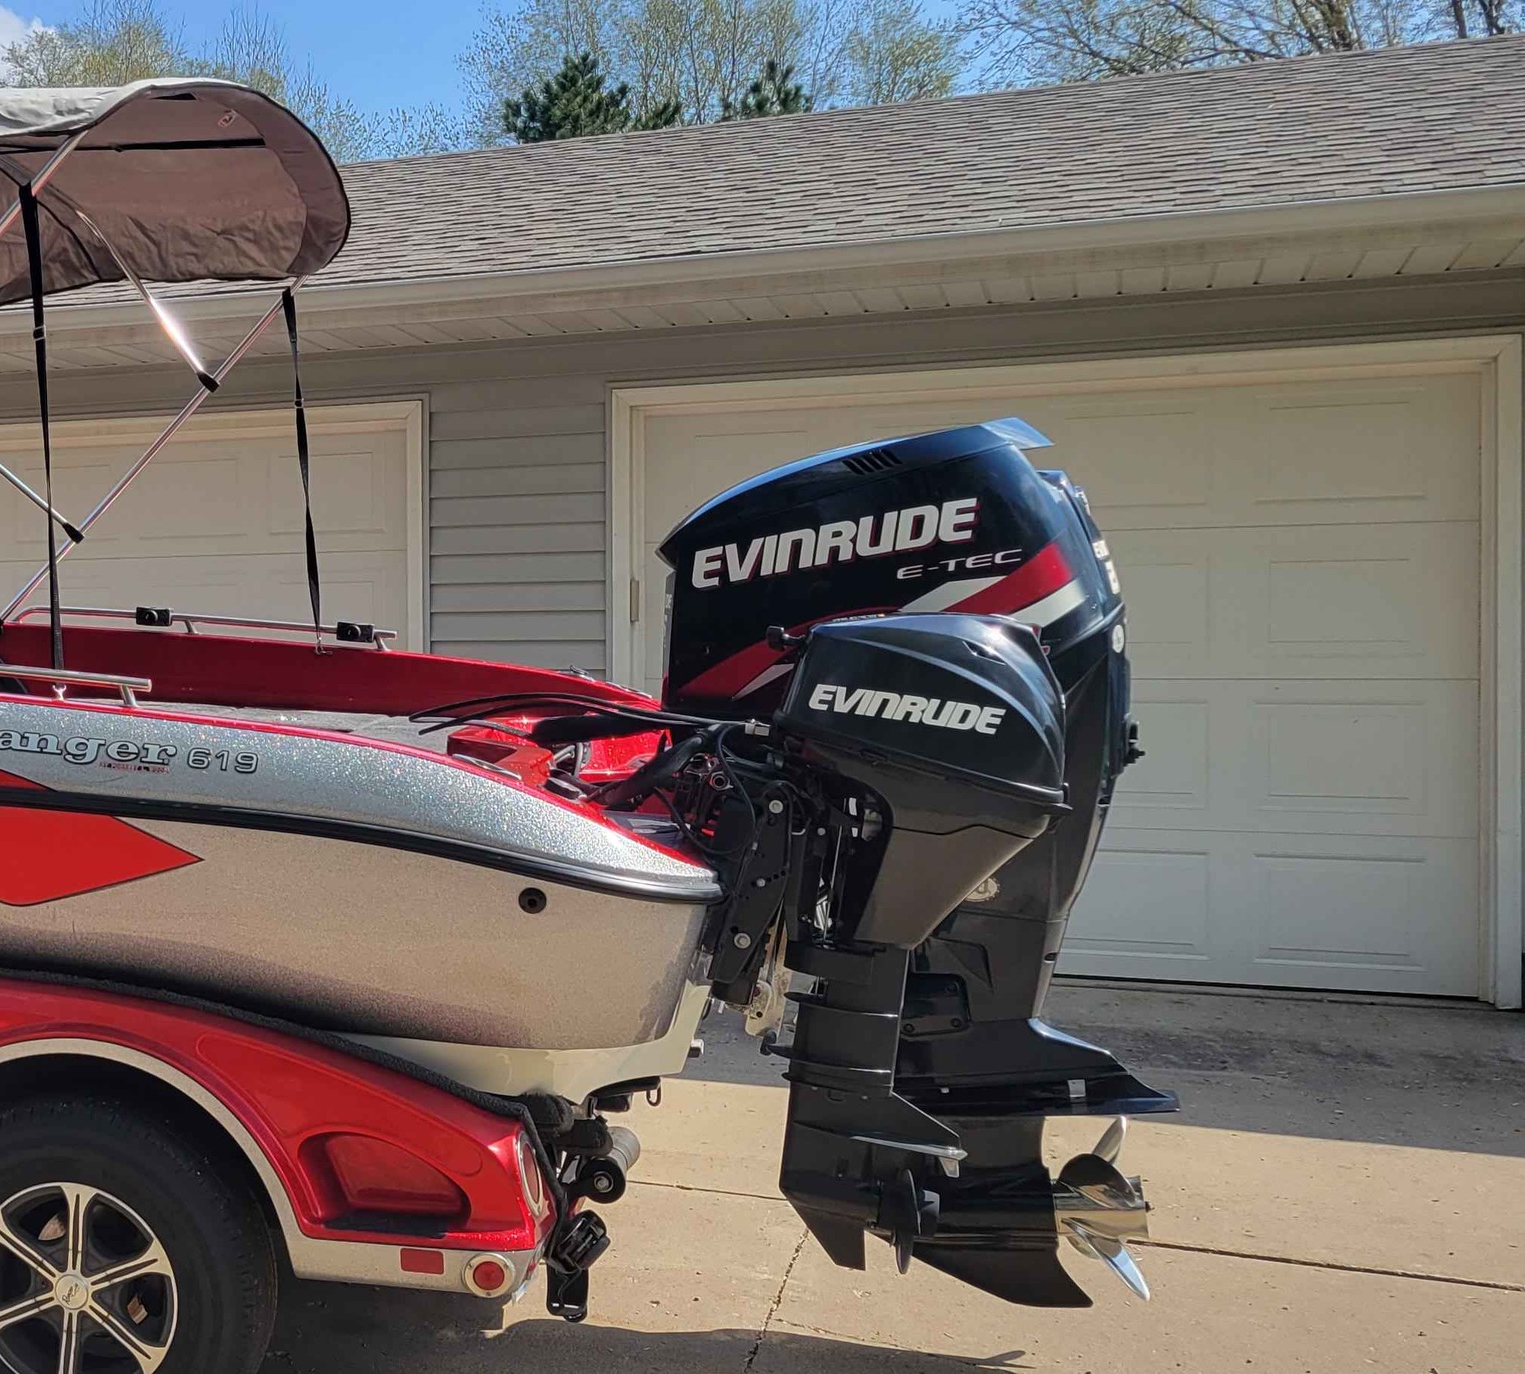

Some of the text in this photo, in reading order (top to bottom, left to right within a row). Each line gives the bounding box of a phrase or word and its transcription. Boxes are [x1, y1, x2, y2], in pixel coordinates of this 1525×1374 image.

[691, 497, 978, 589] EVINRUDE
[896, 548, 1023, 580] E-TEC
[808, 683, 1006, 736] EVINRUDE
[186, 746, 259, 774] 619
